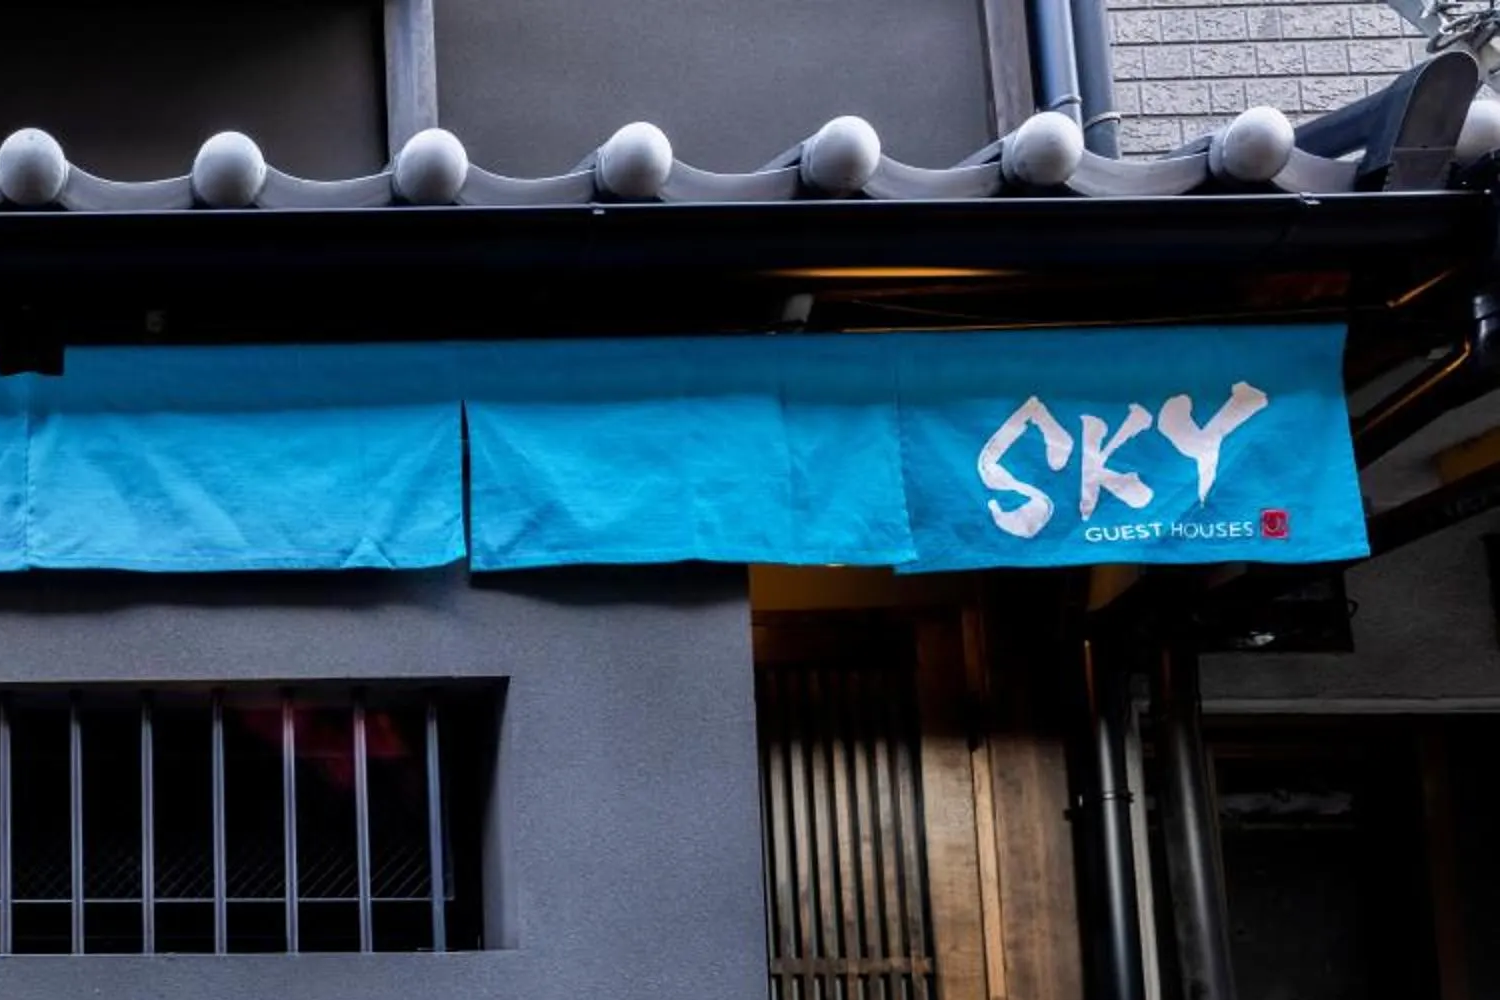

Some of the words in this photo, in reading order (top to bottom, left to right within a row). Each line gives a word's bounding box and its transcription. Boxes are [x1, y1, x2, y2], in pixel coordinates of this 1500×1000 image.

[977, 381, 1269, 539] SKY
[1084, 522, 1162, 542] GUEST
[1170, 521, 1255, 540] HOUSES
